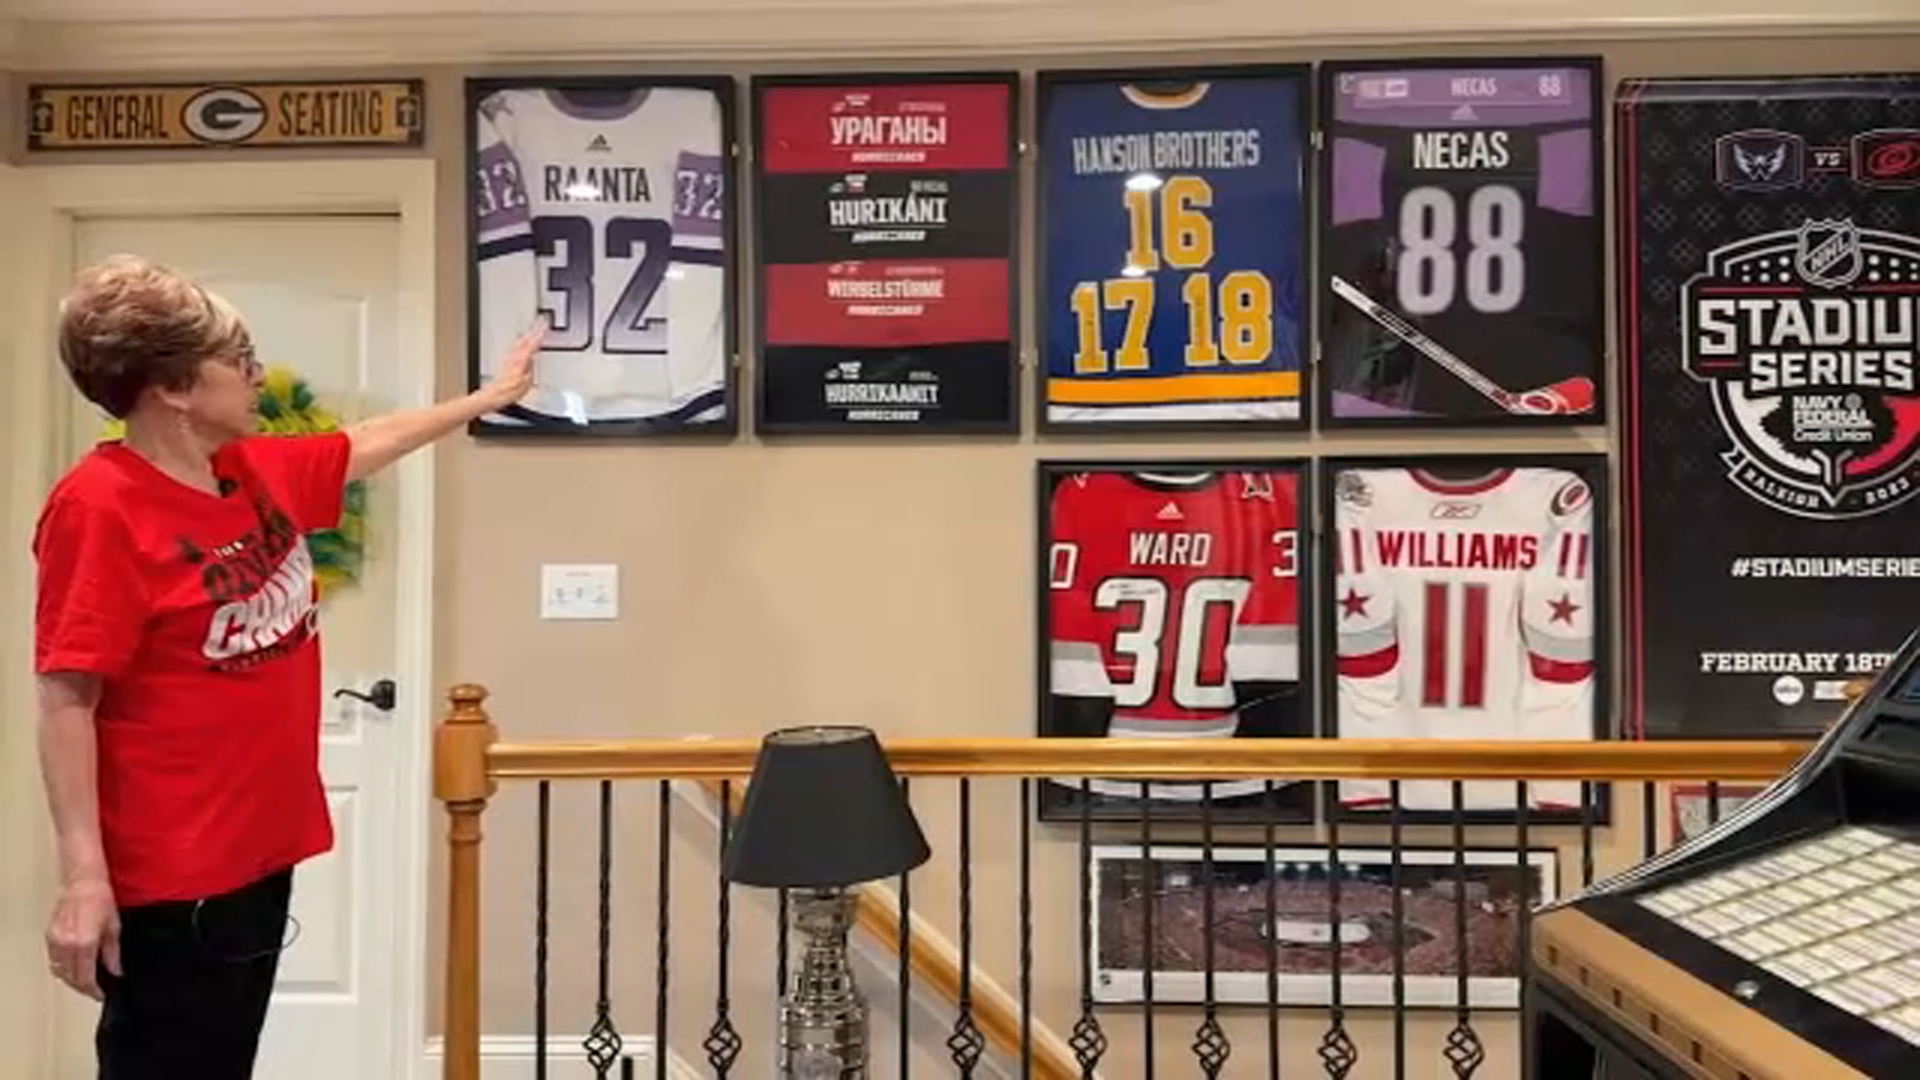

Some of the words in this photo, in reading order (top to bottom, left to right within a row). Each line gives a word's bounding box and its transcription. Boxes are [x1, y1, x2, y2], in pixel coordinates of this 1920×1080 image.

[66, 95, 169, 140] GENERAL
[278, 90, 383, 137] SEATING
[829, 115, 947, 146] УРАГАНЫ
[1072, 132, 1151, 175] HANSON
[1154, 129, 1261, 170] BROTHERS
[1413, 131, 1510, 170] NECAS
[1814, 152, 1841, 167] VS
[1124, 175, 1213, 271] 16
[1397, 184, 1525, 315] 88
[1809, 236, 1849, 272] NHL
[532, 215, 673, 355] 32
[1071, 278, 1154, 373] 17
[1183, 269, 1273, 367] 18
[1700, 297, 1920, 355] STADIU
[1750, 350, 1914, 391] SERIES
[1793, 395, 1842, 409] NAVY
[1793, 408, 1873, 427] FEDERAL
[1743, 467, 1820, 508] RALEIGH
[1129, 532, 1212, 567] WARD
[1376, 530, 1539, 571] WILLIAMS
[1095, 576, 1254, 710] 30
[1420, 581, 1491, 710] 11
[1700, 652, 1840, 673] FEBRUARY
